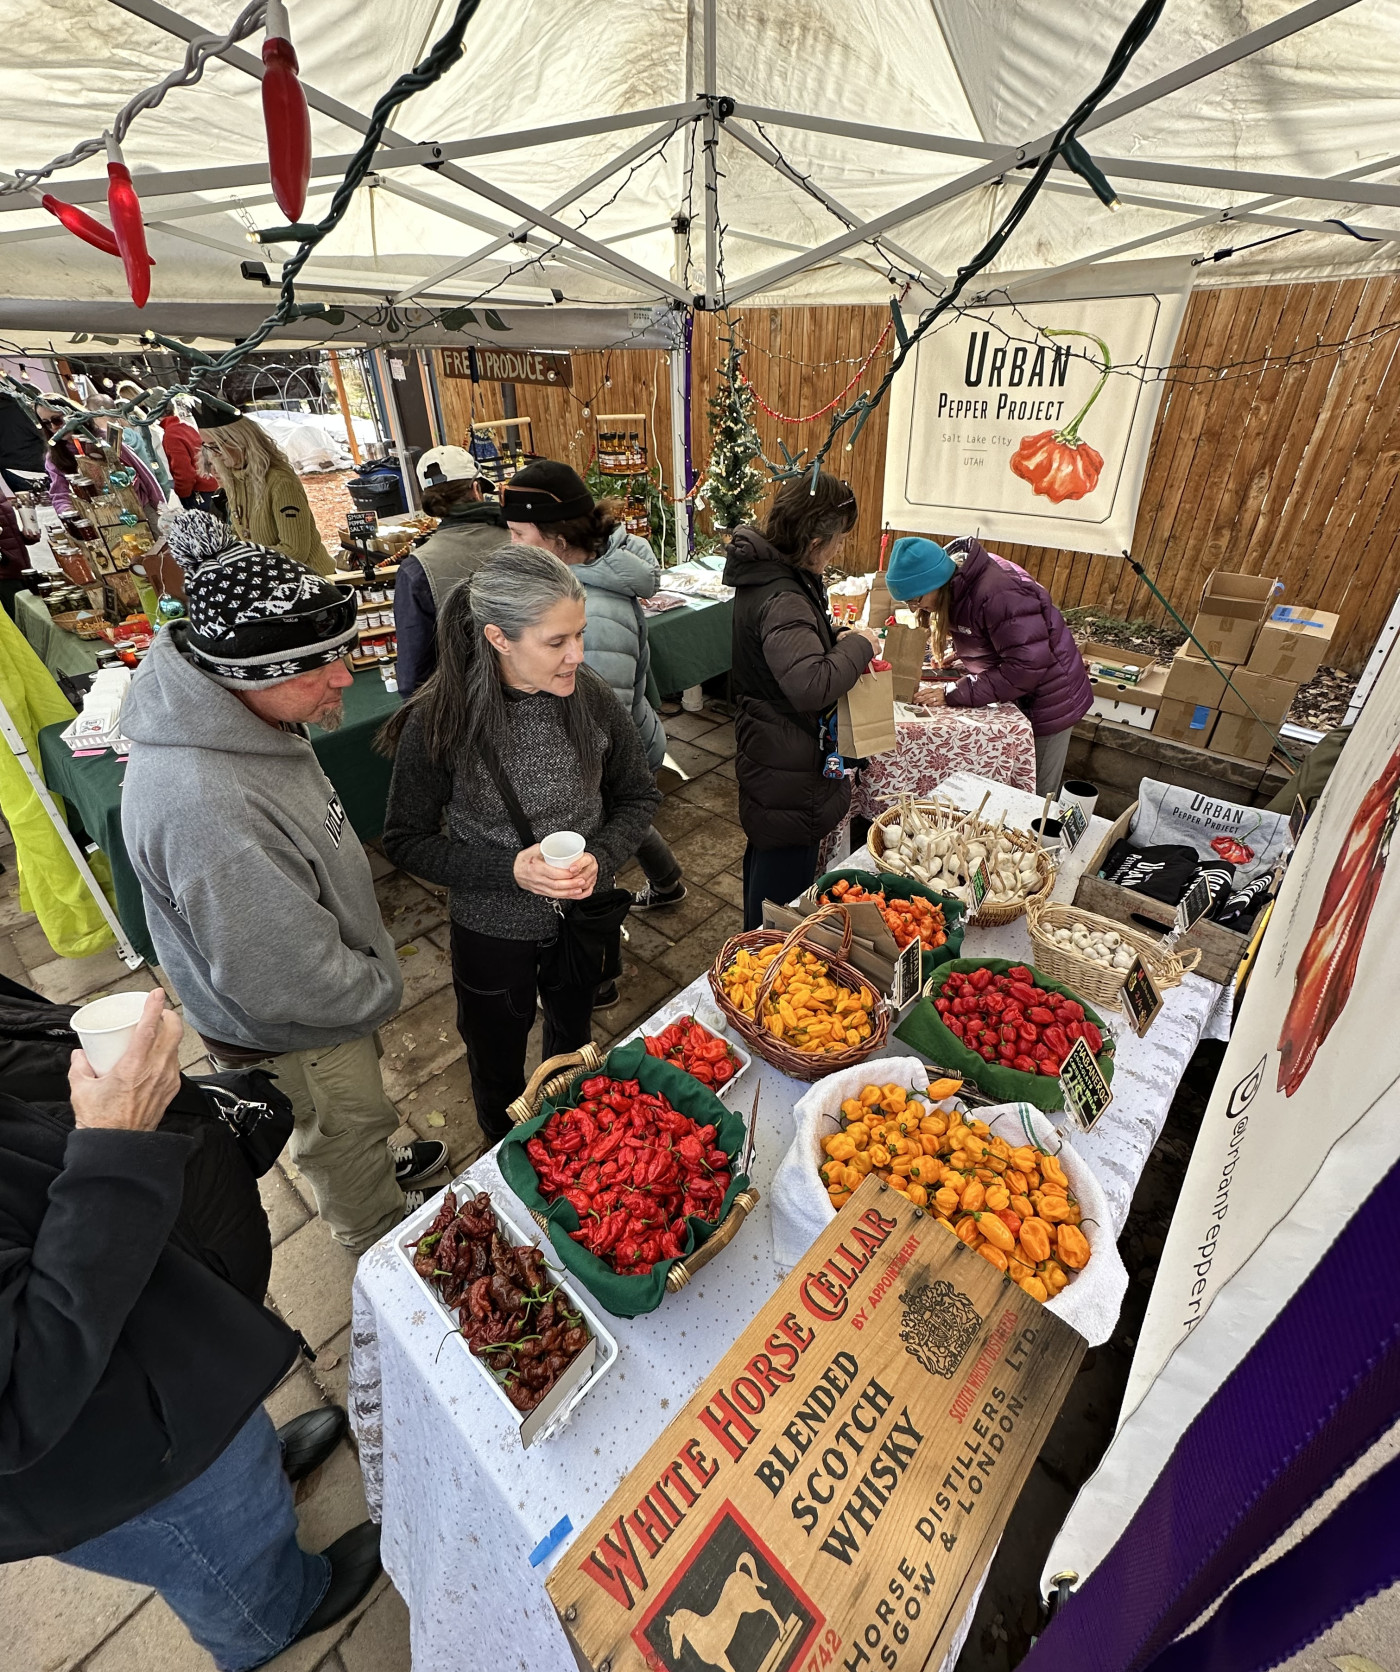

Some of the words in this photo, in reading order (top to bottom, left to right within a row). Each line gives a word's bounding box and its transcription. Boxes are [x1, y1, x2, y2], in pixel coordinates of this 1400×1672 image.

[443, 350, 483, 375] FREH
[485, 352, 545, 380] PRODUCE
[965, 331, 1072, 387] URBAN
[938, 393, 988, 419] PEPPER
[996, 393, 1064, 421] PROJECT
[941, 434, 961, 443] Salt
[967, 435, 986, 444] Lake
[992, 435, 1012, 446] City
[964, 458, 985, 467] UTAH
[1172, 807, 1200, 825] PEPPER
[1204, 818, 1239, 834] PROJECT
[1190, 794, 1244, 824] URBAN
[1077, 1043, 1109, 1104] HABANEROS
[851, 1307, 868, 1331] BY
[868, 1234, 920, 1309] APPOINTMENT
[949, 1384, 977, 1424] SCOTCH
[967, 1353, 994, 1389] WHISKY
[984, 1309, 1018, 1366] DISTILLERS
[578, 1438, 720, 1610] WHITE
[697, 1312, 815, 1463] HORSE
[800, 1208, 897, 1321] CELLAR
[754, 1351, 858, 1498] BLENDED
[791, 1376, 894, 1537] SCOTCH
[819, 1405, 924, 1565] WHISKY
[844, 1557, 916, 1672] HORSE
[915, 1386, 1006, 1543] DISTILLERS
[1004, 1327, 1040, 1373] LTD.
[880, 1561, 936, 1671] SGOW
[940, 1531, 957, 1552] &
[957, 1395, 1028, 1515] LONDON.
